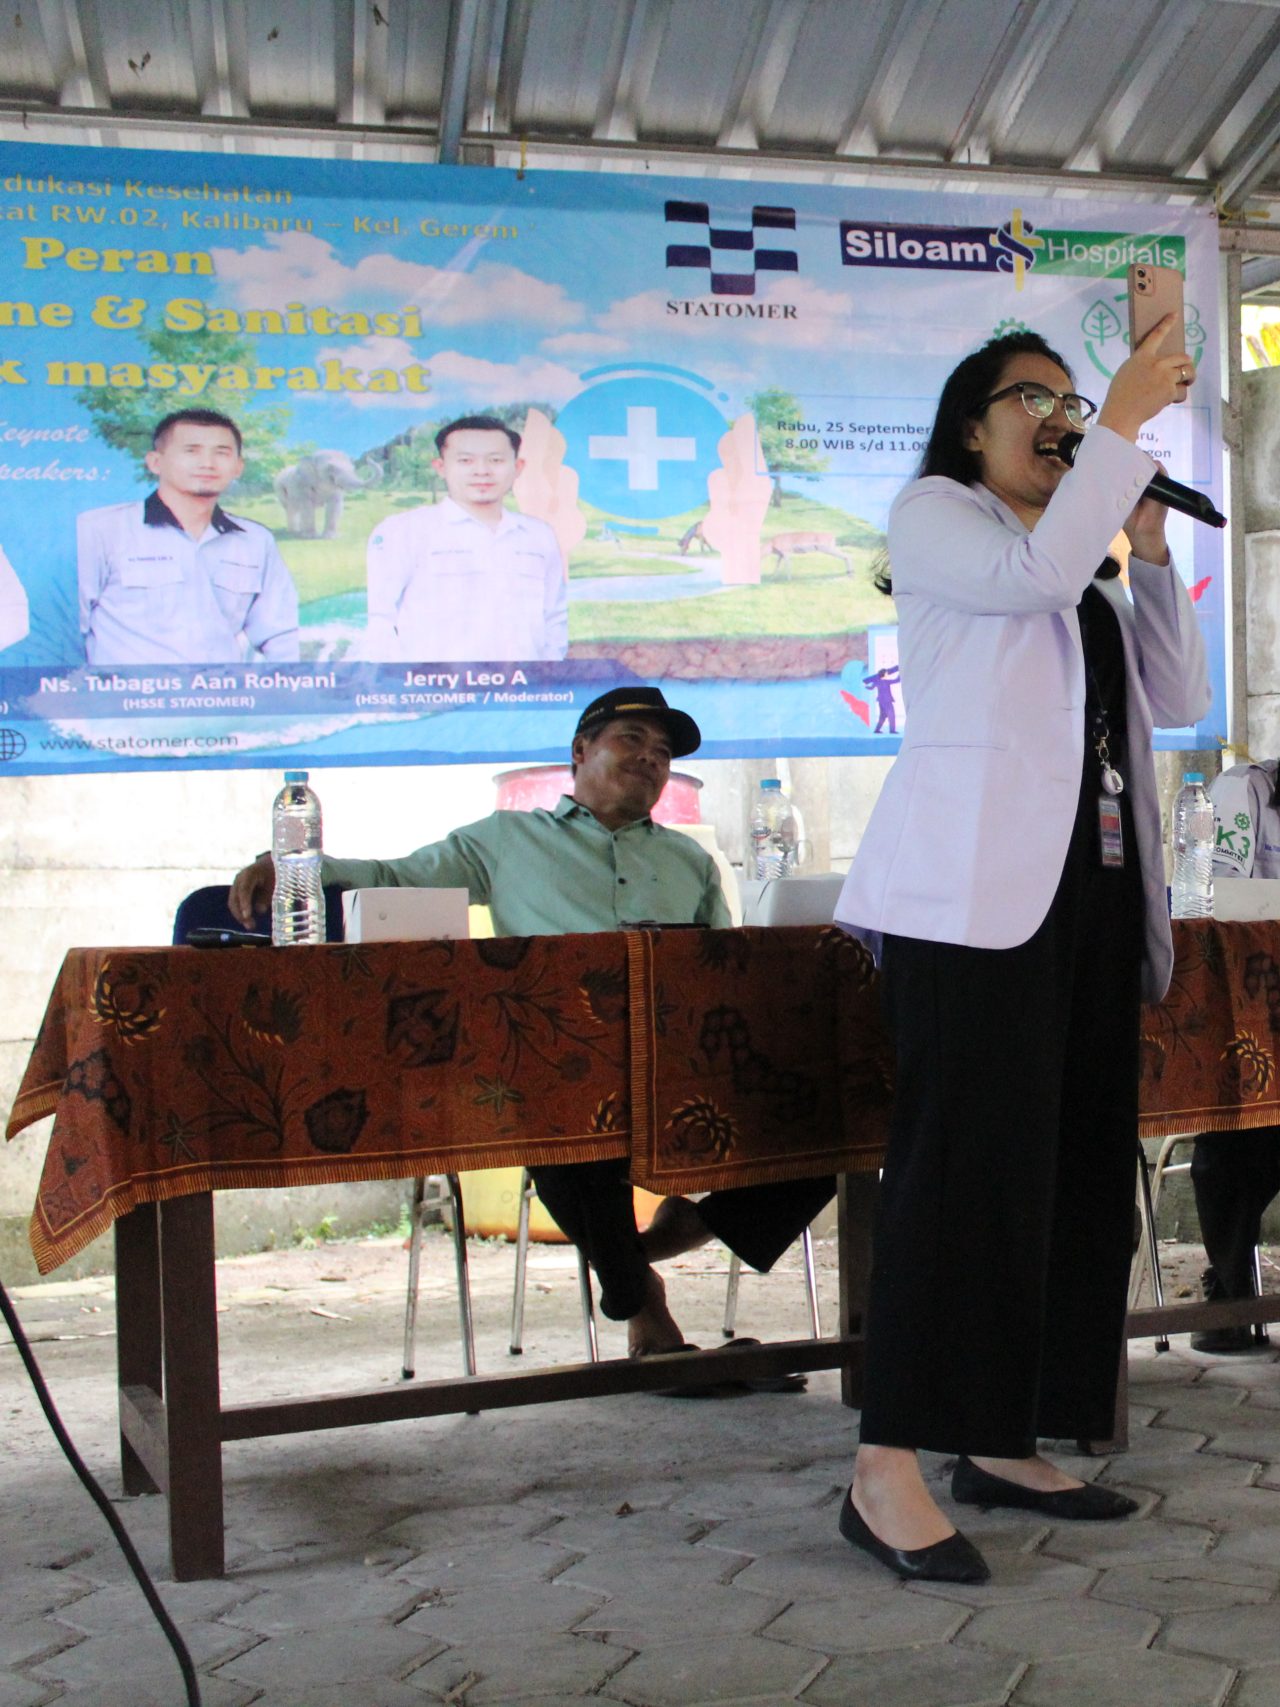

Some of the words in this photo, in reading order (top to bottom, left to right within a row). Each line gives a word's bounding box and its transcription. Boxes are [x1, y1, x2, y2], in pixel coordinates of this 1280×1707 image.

[3, 173, 113, 197] dukasi
[124, 180, 293, 205] Kesehatan
[51, 204, 168, 230] RW.02,
[181, 210, 312, 233] Kalibaru
[353, 215, 410, 236] Kel.
[20, 236, 215, 275] Peran
[845, 229, 988, 263] Siloam
[1048, 238, 1178, 270] Hospitals
[0, 301, 73, 328] ne
[91, 295, 146, 330] &
[165, 298, 423, 338] Sanitasi
[666, 300, 798, 320] STATOMER
[46, 359, 431, 395] masyarakat
[777, 420, 821, 433] Rabu,
[826, 421, 844, 433] 25
[849, 422, 931, 435] September
[785, 438, 818, 449] 8.00
[823, 439, 855, 450] WIB
[859, 439, 884, 452] s/d
[0, 459, 112, 481] peakers:
[40, 677, 78, 693] Ns.
[85, 674, 182, 694] Tubagus
[191, 673, 238, 690] Aan
[244, 671, 336, 692] Rohyani
[403, 670, 459, 689] Jerry
[466, 670, 505, 686] Leo
[511, 669, 528, 685] A
[123, 697, 166, 711] (HSSE
[170, 695, 256, 709] STATOMER)
[355, 693, 396, 707] (HSSE
[401, 692, 476, 705] STATOMER
[494, 690, 575, 704] Moderator)
[40, 734, 239, 751] www.statomer.com
